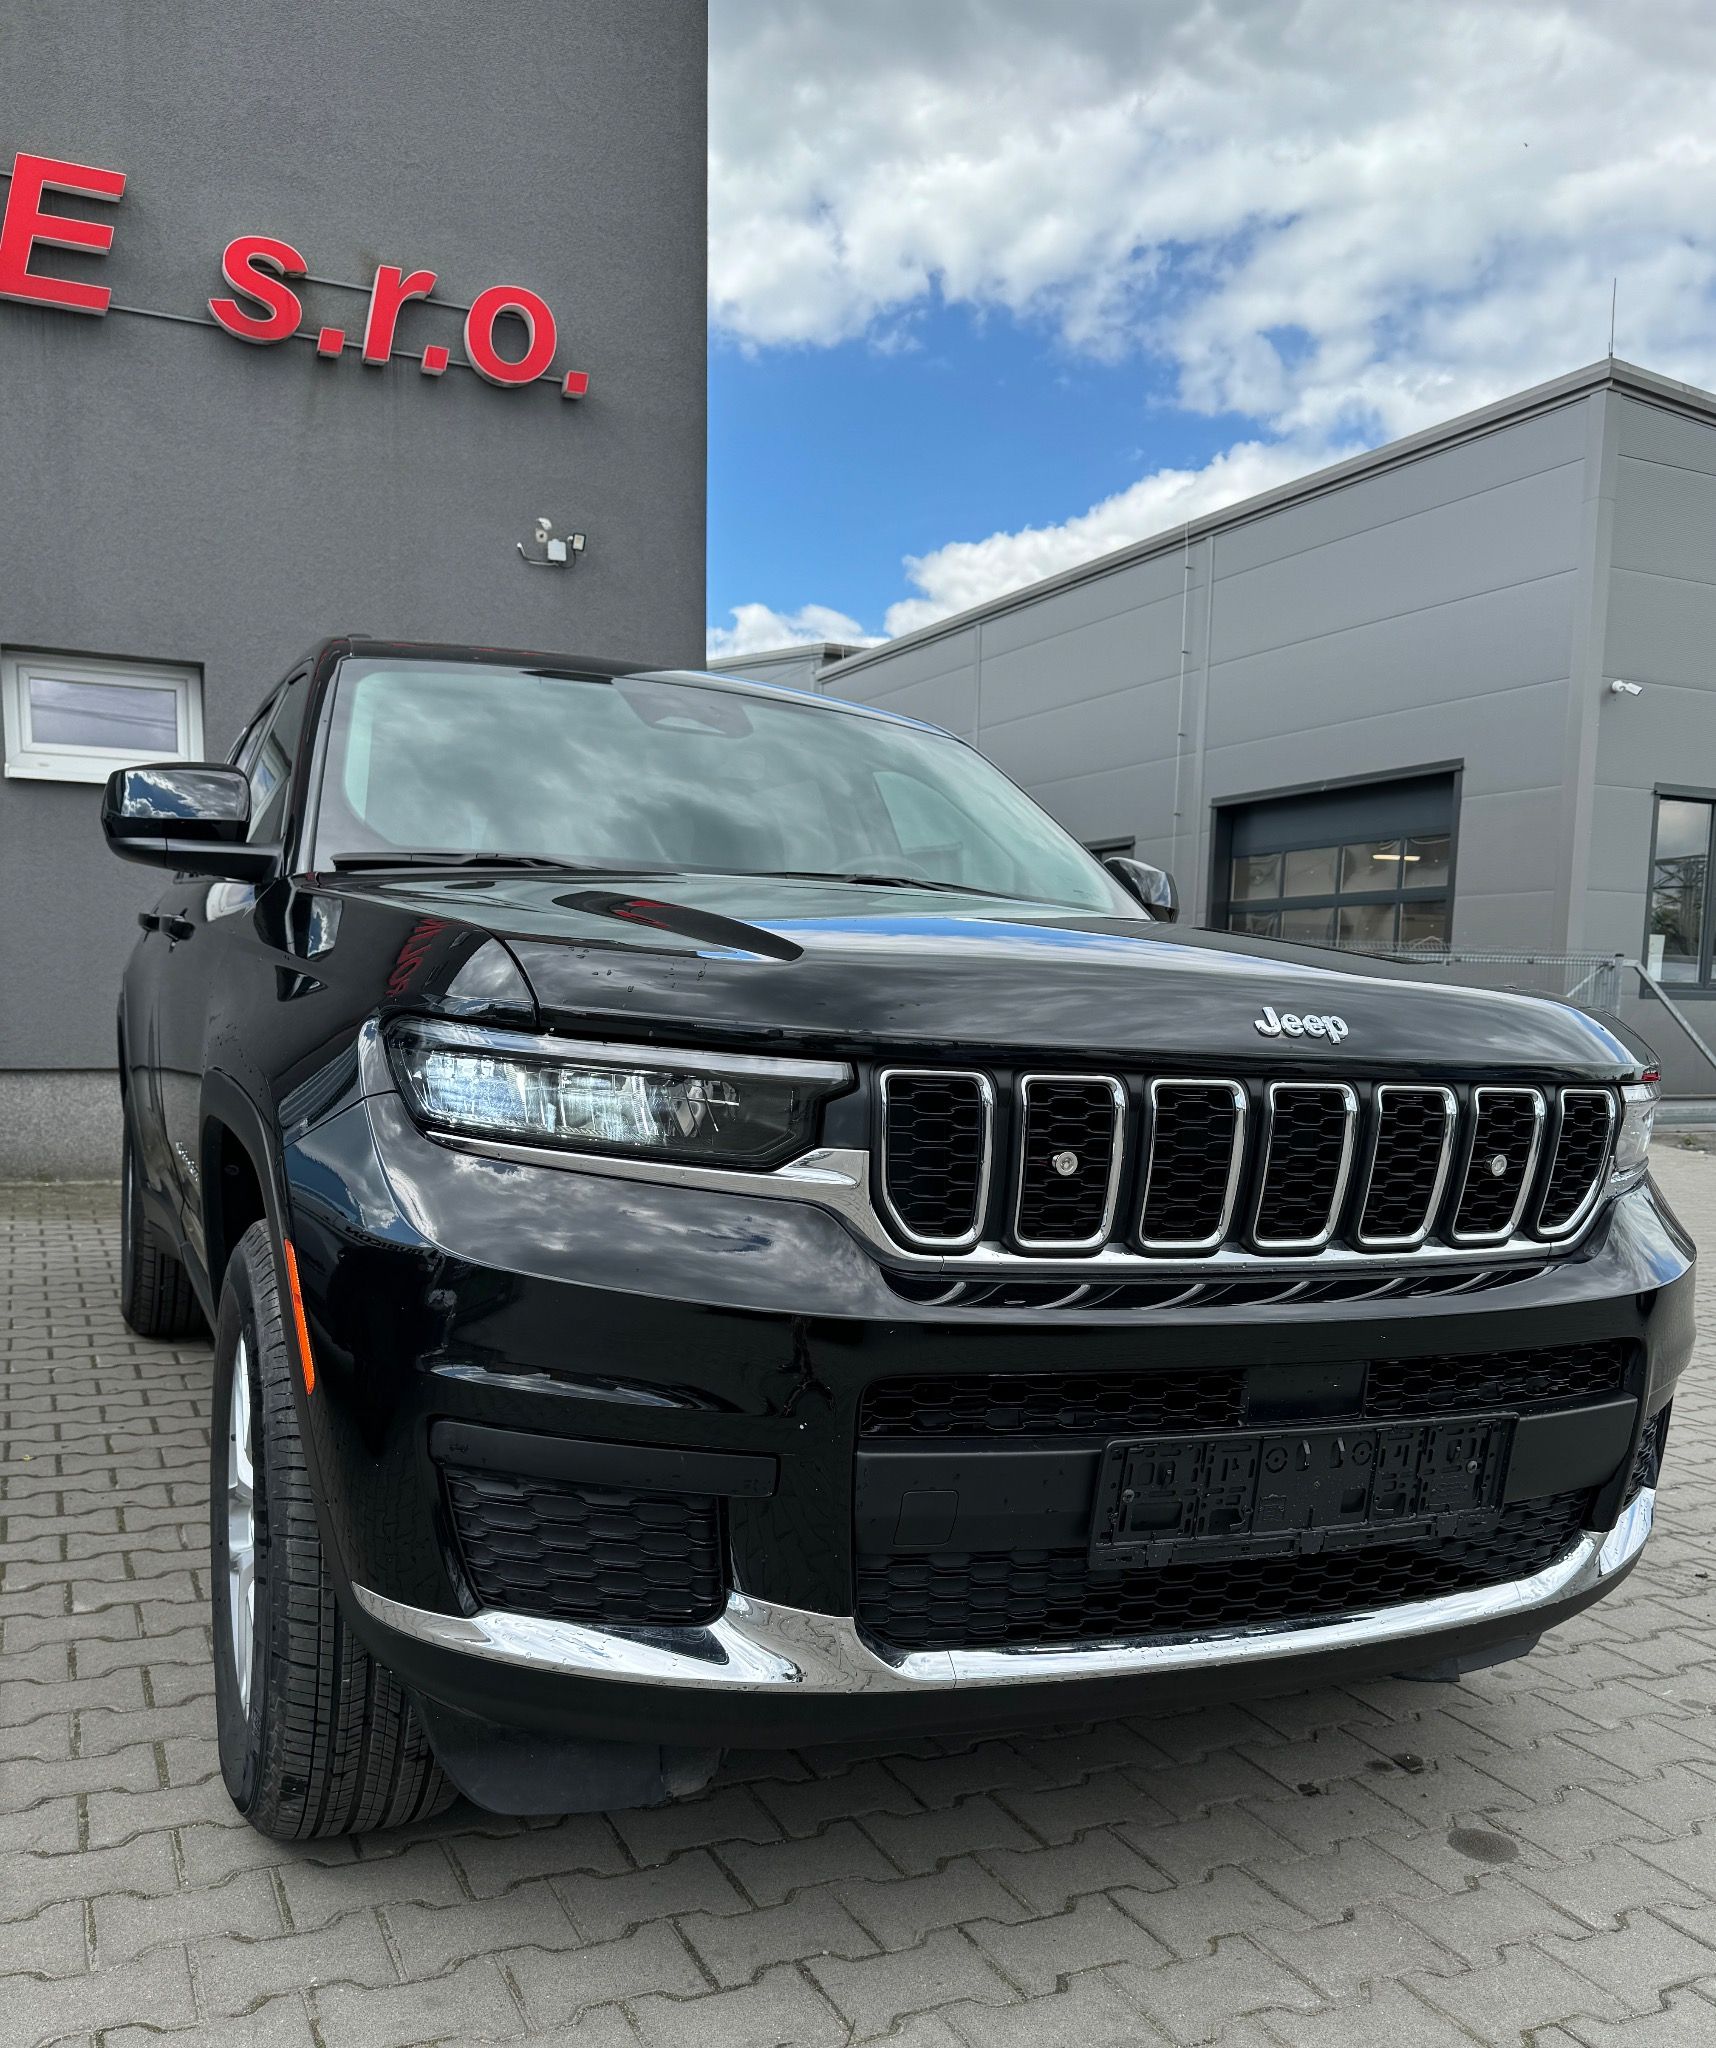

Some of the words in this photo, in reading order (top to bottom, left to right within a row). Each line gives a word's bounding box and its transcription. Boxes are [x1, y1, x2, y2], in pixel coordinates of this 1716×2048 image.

[0, 152, 127, 316] E
[208, 235, 590, 399] s.r.o.
[1254, 1006, 1349, 1045] Jeep
